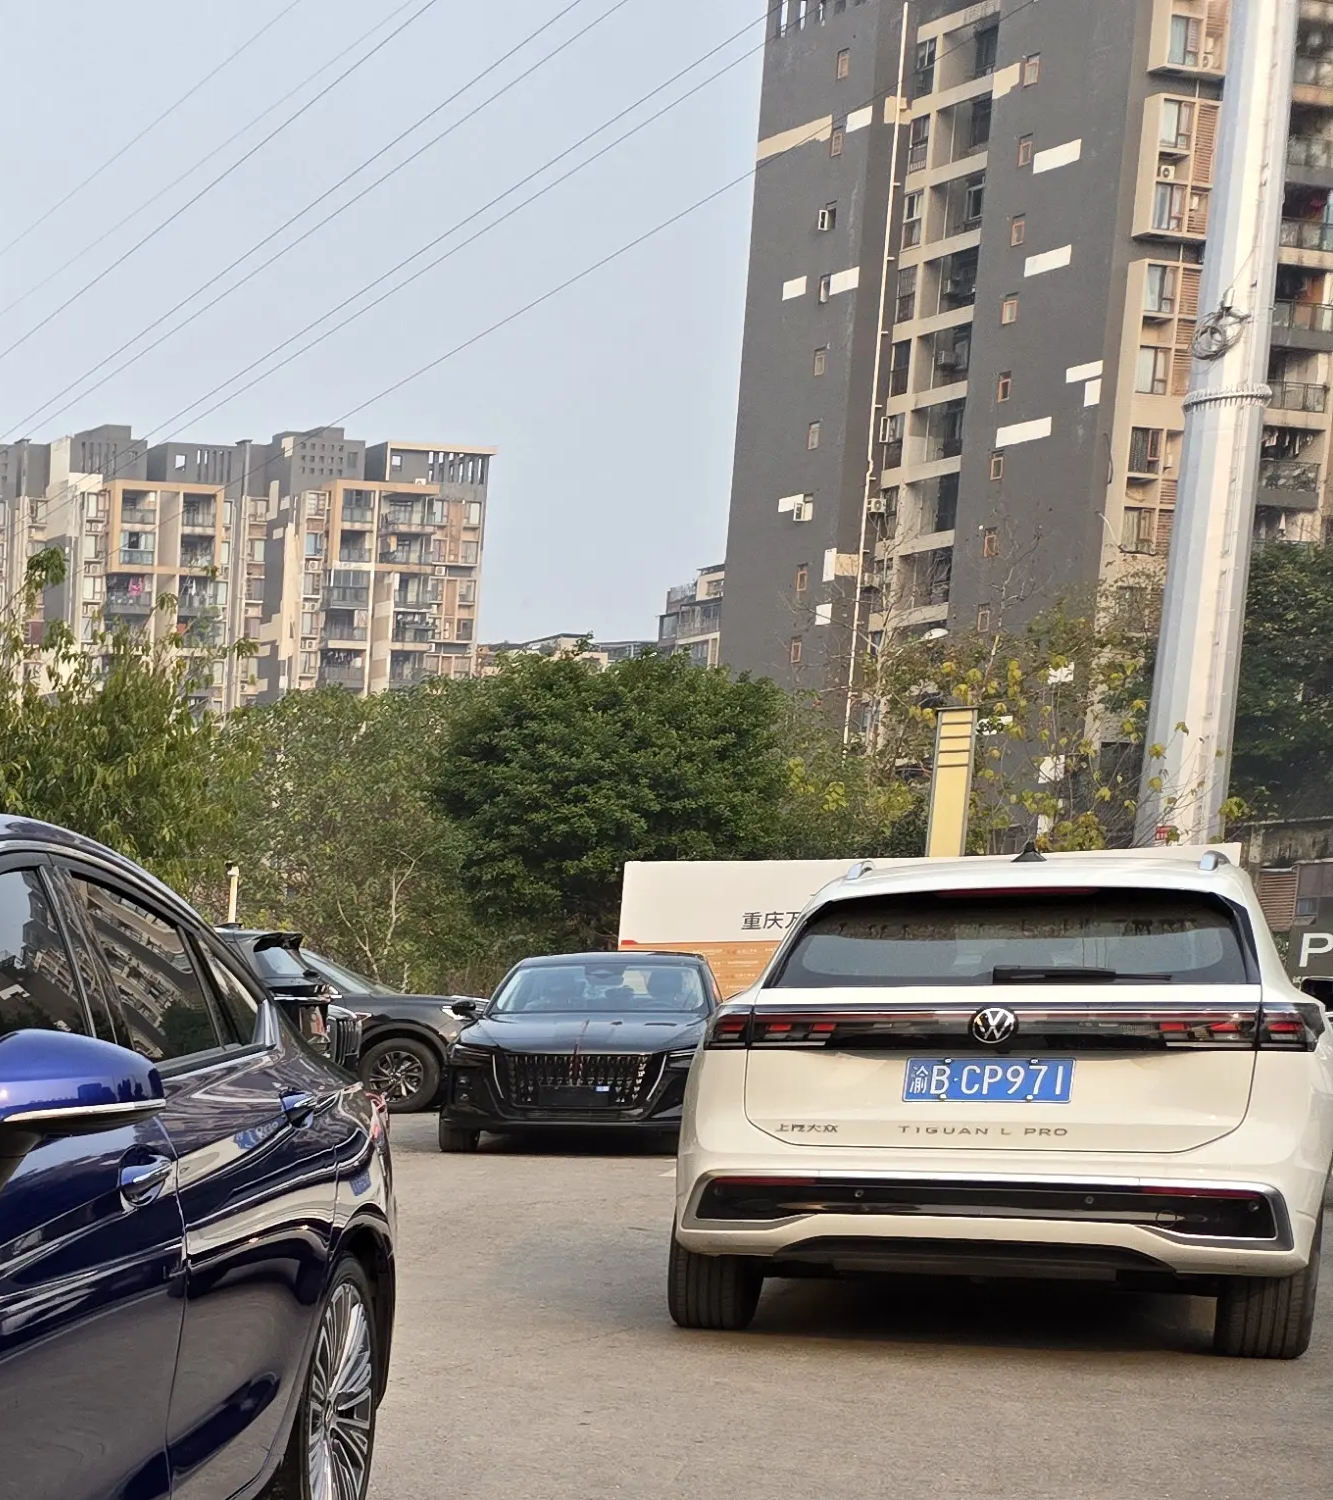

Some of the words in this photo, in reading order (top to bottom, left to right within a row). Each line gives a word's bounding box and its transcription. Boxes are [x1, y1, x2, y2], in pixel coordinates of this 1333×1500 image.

[1299, 932, 1333, 968] P
[775, 1123, 839, 1133] 上汽大众
[898, 1125, 989, 1136] TIGUAN
[1000, 1127, 1013, 1136] L
[1024, 1127, 1069, 1137] PRO
